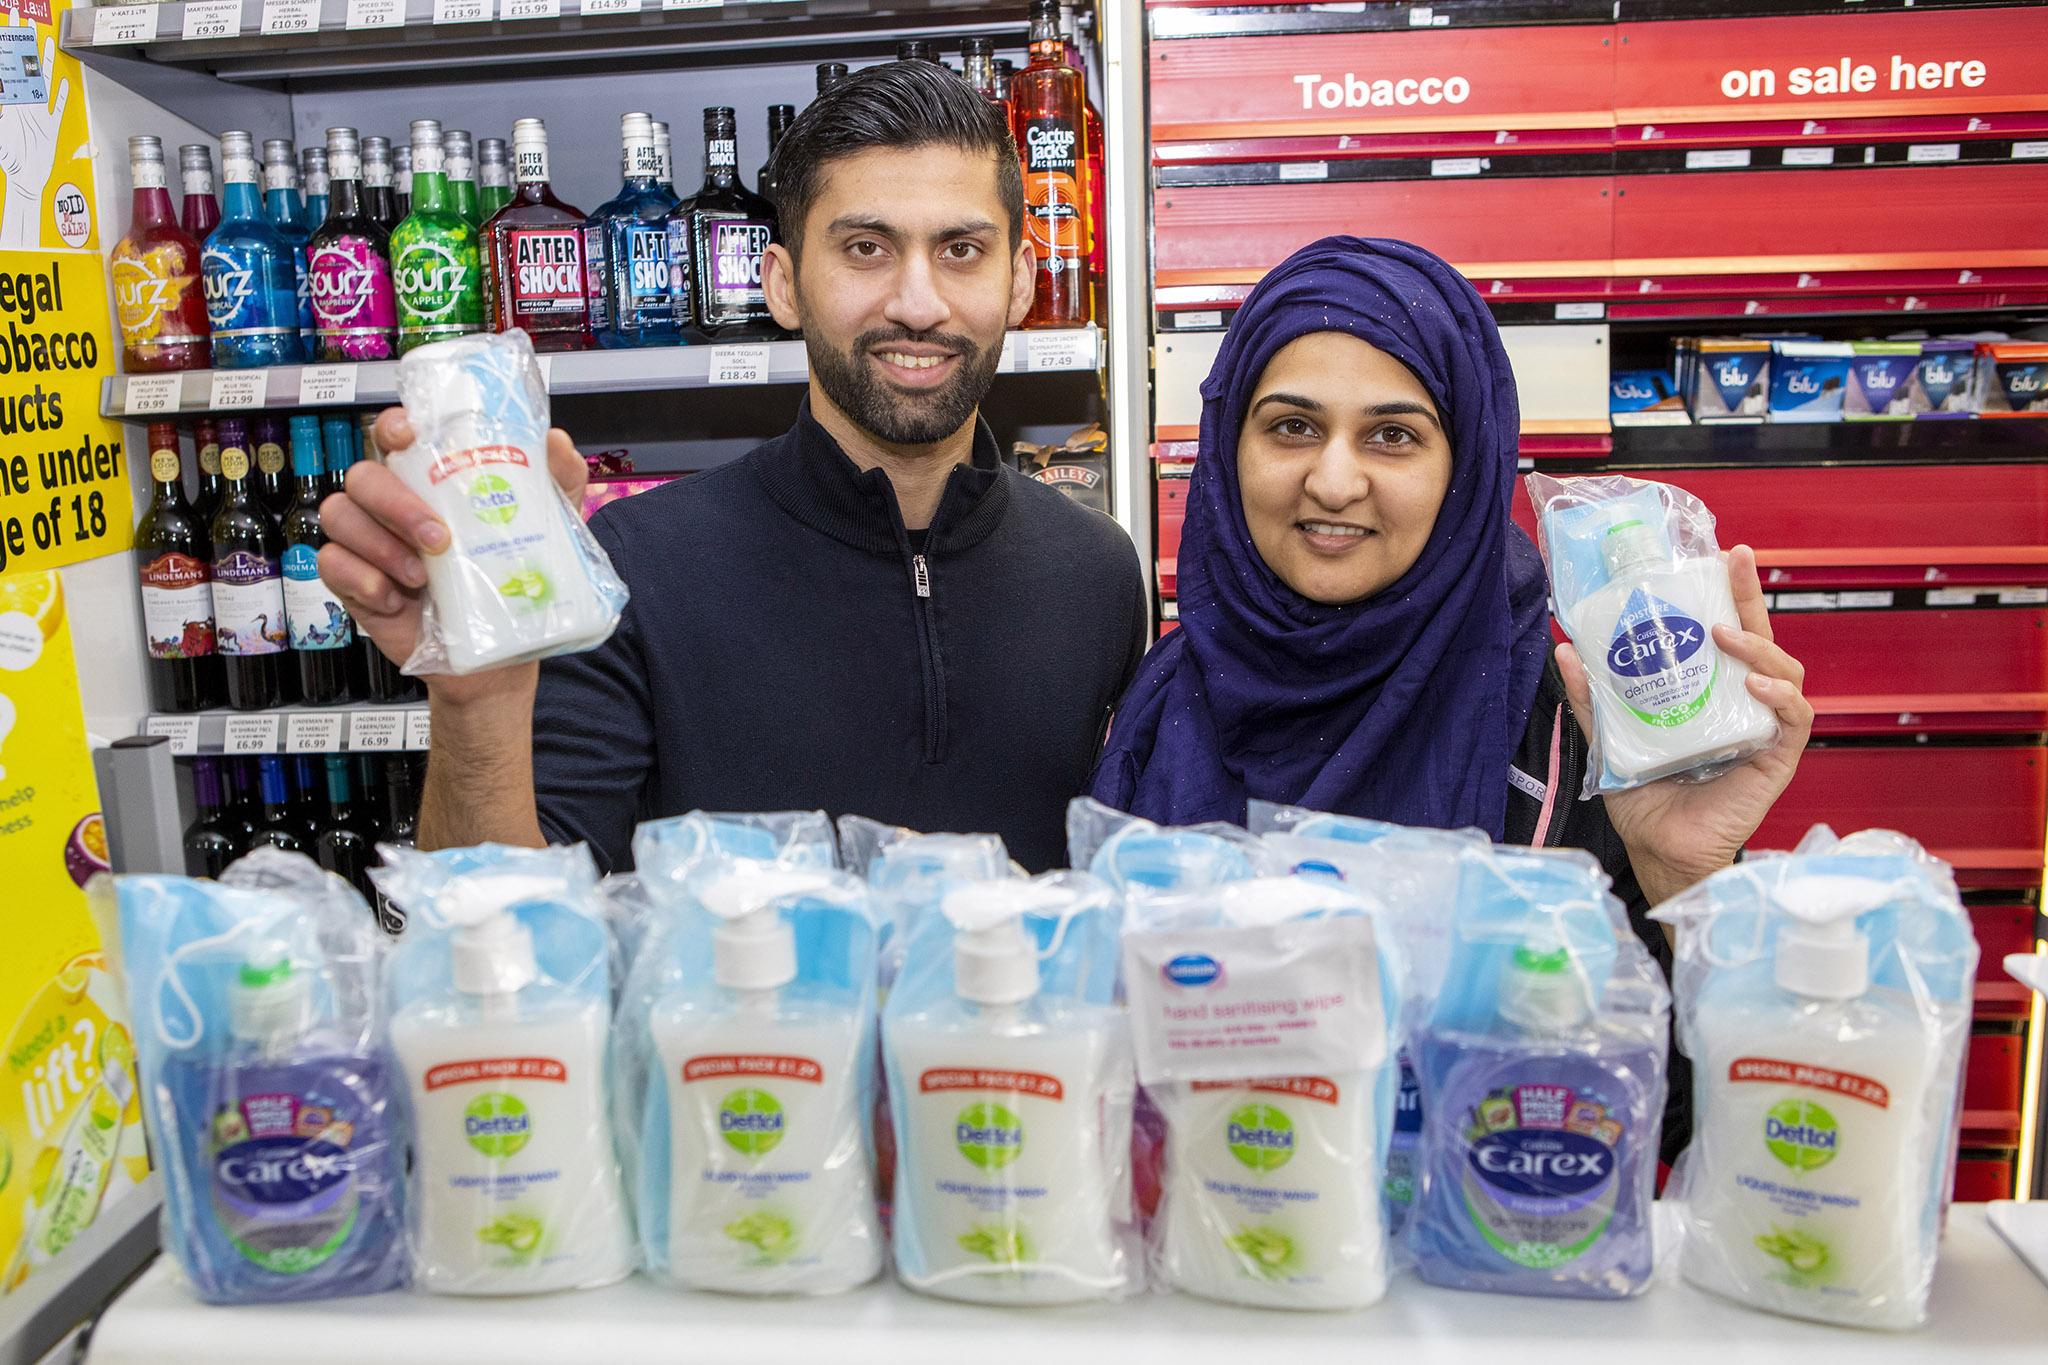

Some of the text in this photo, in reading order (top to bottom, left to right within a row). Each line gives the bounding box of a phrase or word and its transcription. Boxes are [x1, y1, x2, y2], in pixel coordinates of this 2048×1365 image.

[187, 3, 238, 13] MARTINI BIANCO
[444, 8, 481, 19] £13.99
[511, 4, 548, 15] £15.99
[272, 19, 307, 30] £10.99
[365, 15, 384, 24] £23
[118, 29, 136, 40] £11
[196, 24, 225, 35] £9.99
[1293, 55, 1987, 110] Tobacco on sale here
[1027, 126, 1075, 147] Cactus
[709, 140, 735, 153] AFTER
[519, 153, 542, 164] AFTER
[709, 152, 736, 166] SHOCK
[1037, 159, 1075, 168] SCHNAPPS
[519, 164, 544, 177] SHOCK
[716, 224, 770, 255] AFTER
[517, 236, 578, 266] AFTER
[519, 265, 581, 294] SHOCK
[412, 295, 443, 306] APPLE
[1041, 356, 1072, 366] £7.49
[720, 371, 756, 380] £18.49
[1719, 367, 1748, 386] blu
[1867, 369, 1896, 389] blu
[1925, 365, 1954, 384] blu
[1613, 382, 1652, 399] blu
[1788, 376, 1820, 394] blu
[2010, 375, 2040, 392] blu
[219, 395, 253, 405] £12.99
[316, 390, 335, 399] £10
[137, 399, 165, 410] £9.99
[38, 434, 121, 490] under
[1034, 468, 1096, 484] BAILEYS
[33, 490, 107, 551] of 18
[1619, 603, 1670, 628] MOISTRE
[1614, 626, 1698, 667] Carex
[1624, 663, 1709, 700] derma care
[1660, 702, 1690, 720] eco
[236, 740, 263, 750] £6.99
[299, 739, 326, 748] £6.99
[361, 736, 388, 746] £6.99
[481, 1063, 518, 1075] PACK
[739, 1060, 774, 1073] PACK
[22, 1017, 96, 1139] lift?
[977, 1073, 1014, 1087] PACK
[1794, 1066, 1836, 1087] PACK
[1521, 1088, 1568, 1100] HALF
[466, 1112, 529, 1137] Dettol
[720, 1110, 783, 1132] Dettol
[957, 1122, 1022, 1146] Dettol
[1227, 1122, 1293, 1149] Dettol
[1766, 1116, 1836, 1150] Dettol
[1477, 1144, 1605, 1176] Carex
[218, 1156, 345, 1186] Carex
